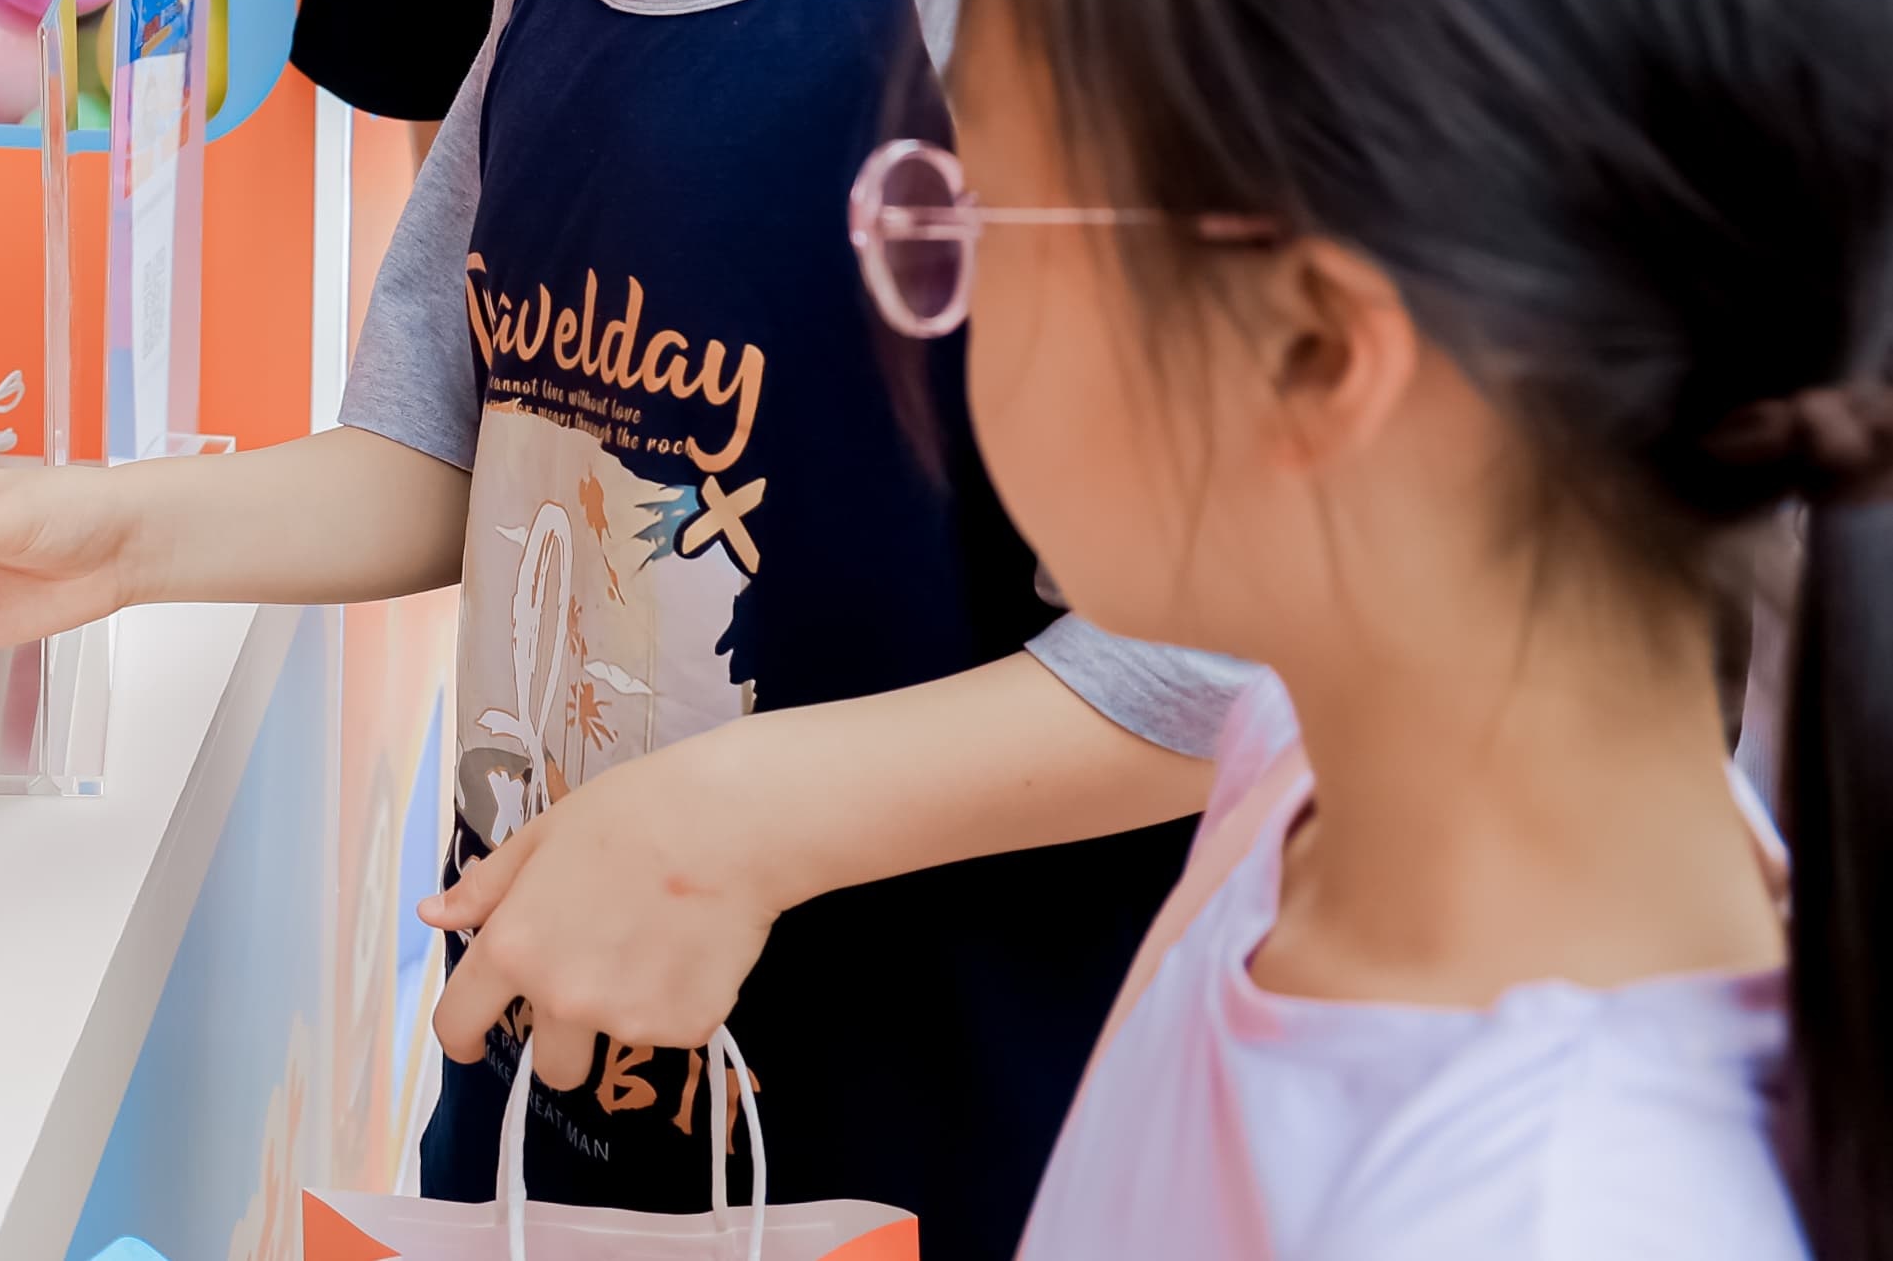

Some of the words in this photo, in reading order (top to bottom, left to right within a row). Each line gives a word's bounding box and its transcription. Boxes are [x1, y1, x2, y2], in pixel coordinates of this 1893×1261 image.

[542, 379, 564, 403] live
[568, 388, 609, 415] without
[612, 398, 642, 424] love
[616, 427, 639, 450] the
[647, 437, 693, 459] roc
[566, 1120, 609, 1162] MAN
